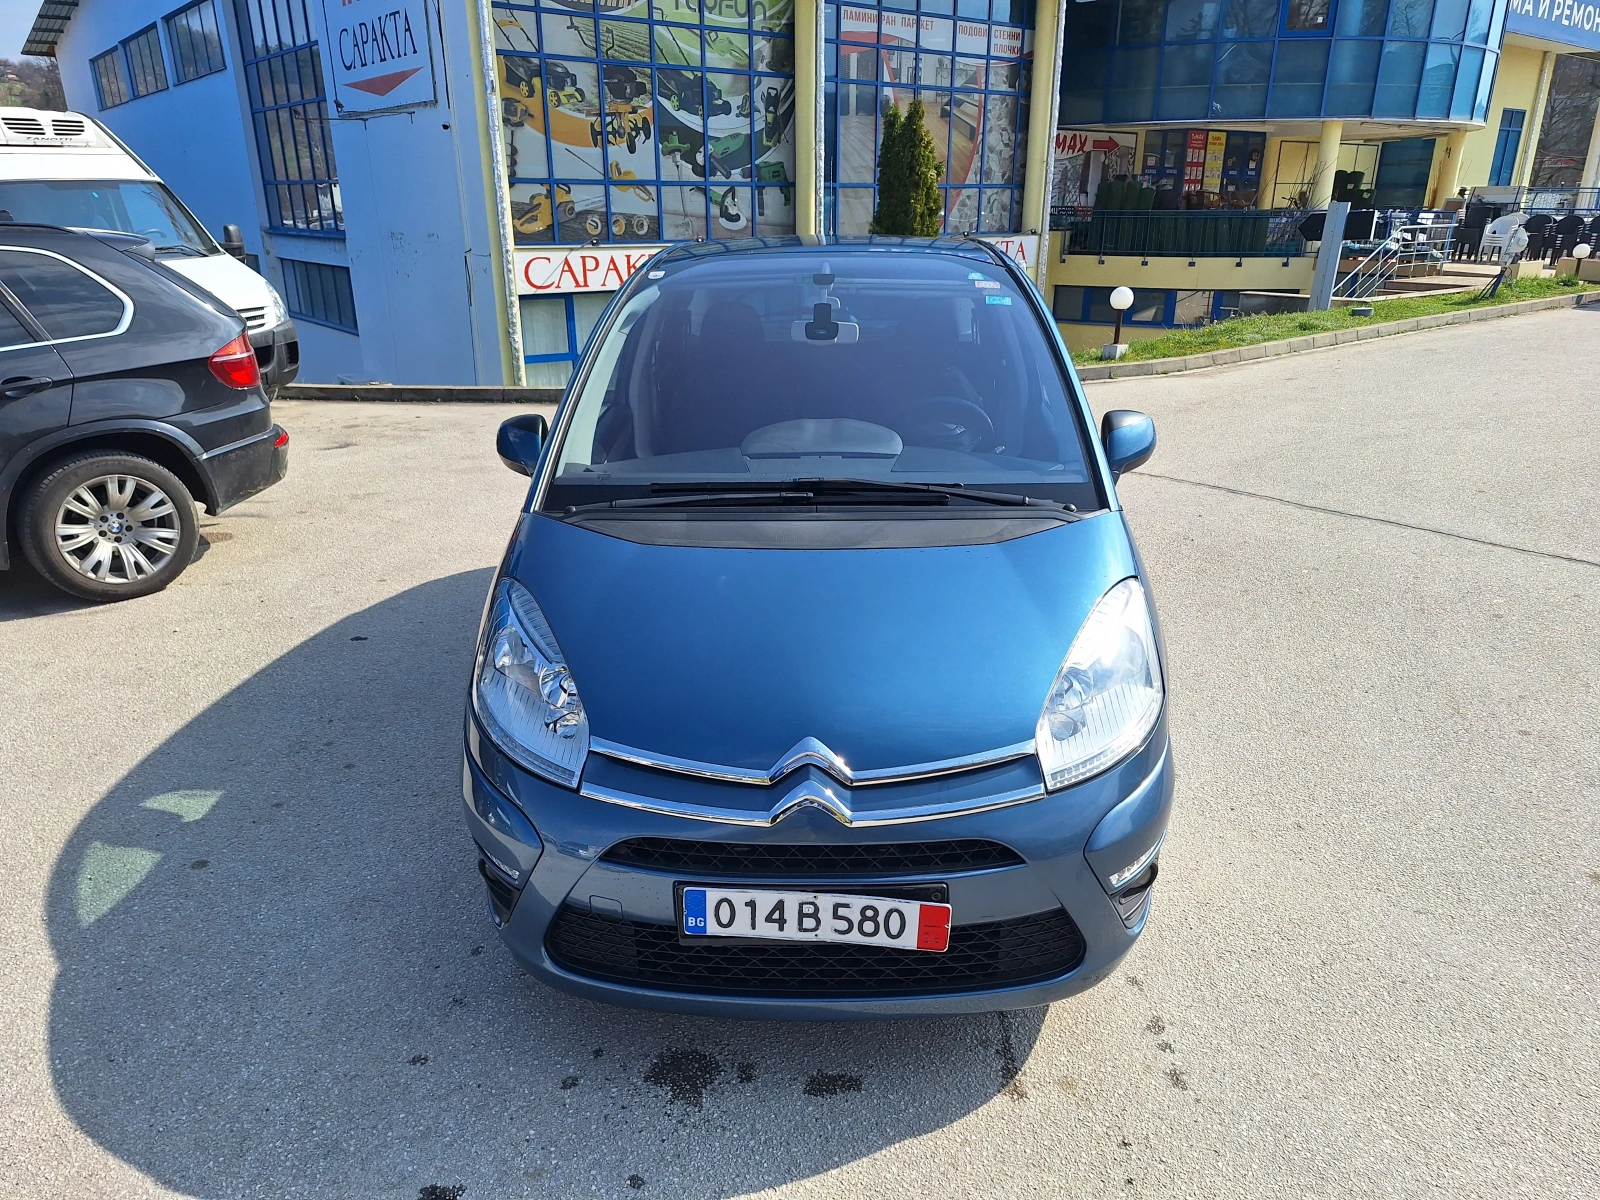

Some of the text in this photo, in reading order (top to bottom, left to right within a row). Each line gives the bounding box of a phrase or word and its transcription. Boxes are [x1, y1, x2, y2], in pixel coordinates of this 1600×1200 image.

[843, 9, 934, 31] ЛАМИНИРАН ПАРКЕТ
[339, 7, 418, 71] САРАКТА
[958, 24, 1020, 41] ПОДОВИ СТЕННИ
[993, 43, 1021, 55] ПЛОЧКИ
[524, 254, 655, 290] САРАК
[687, 916, 705, 927] BG
